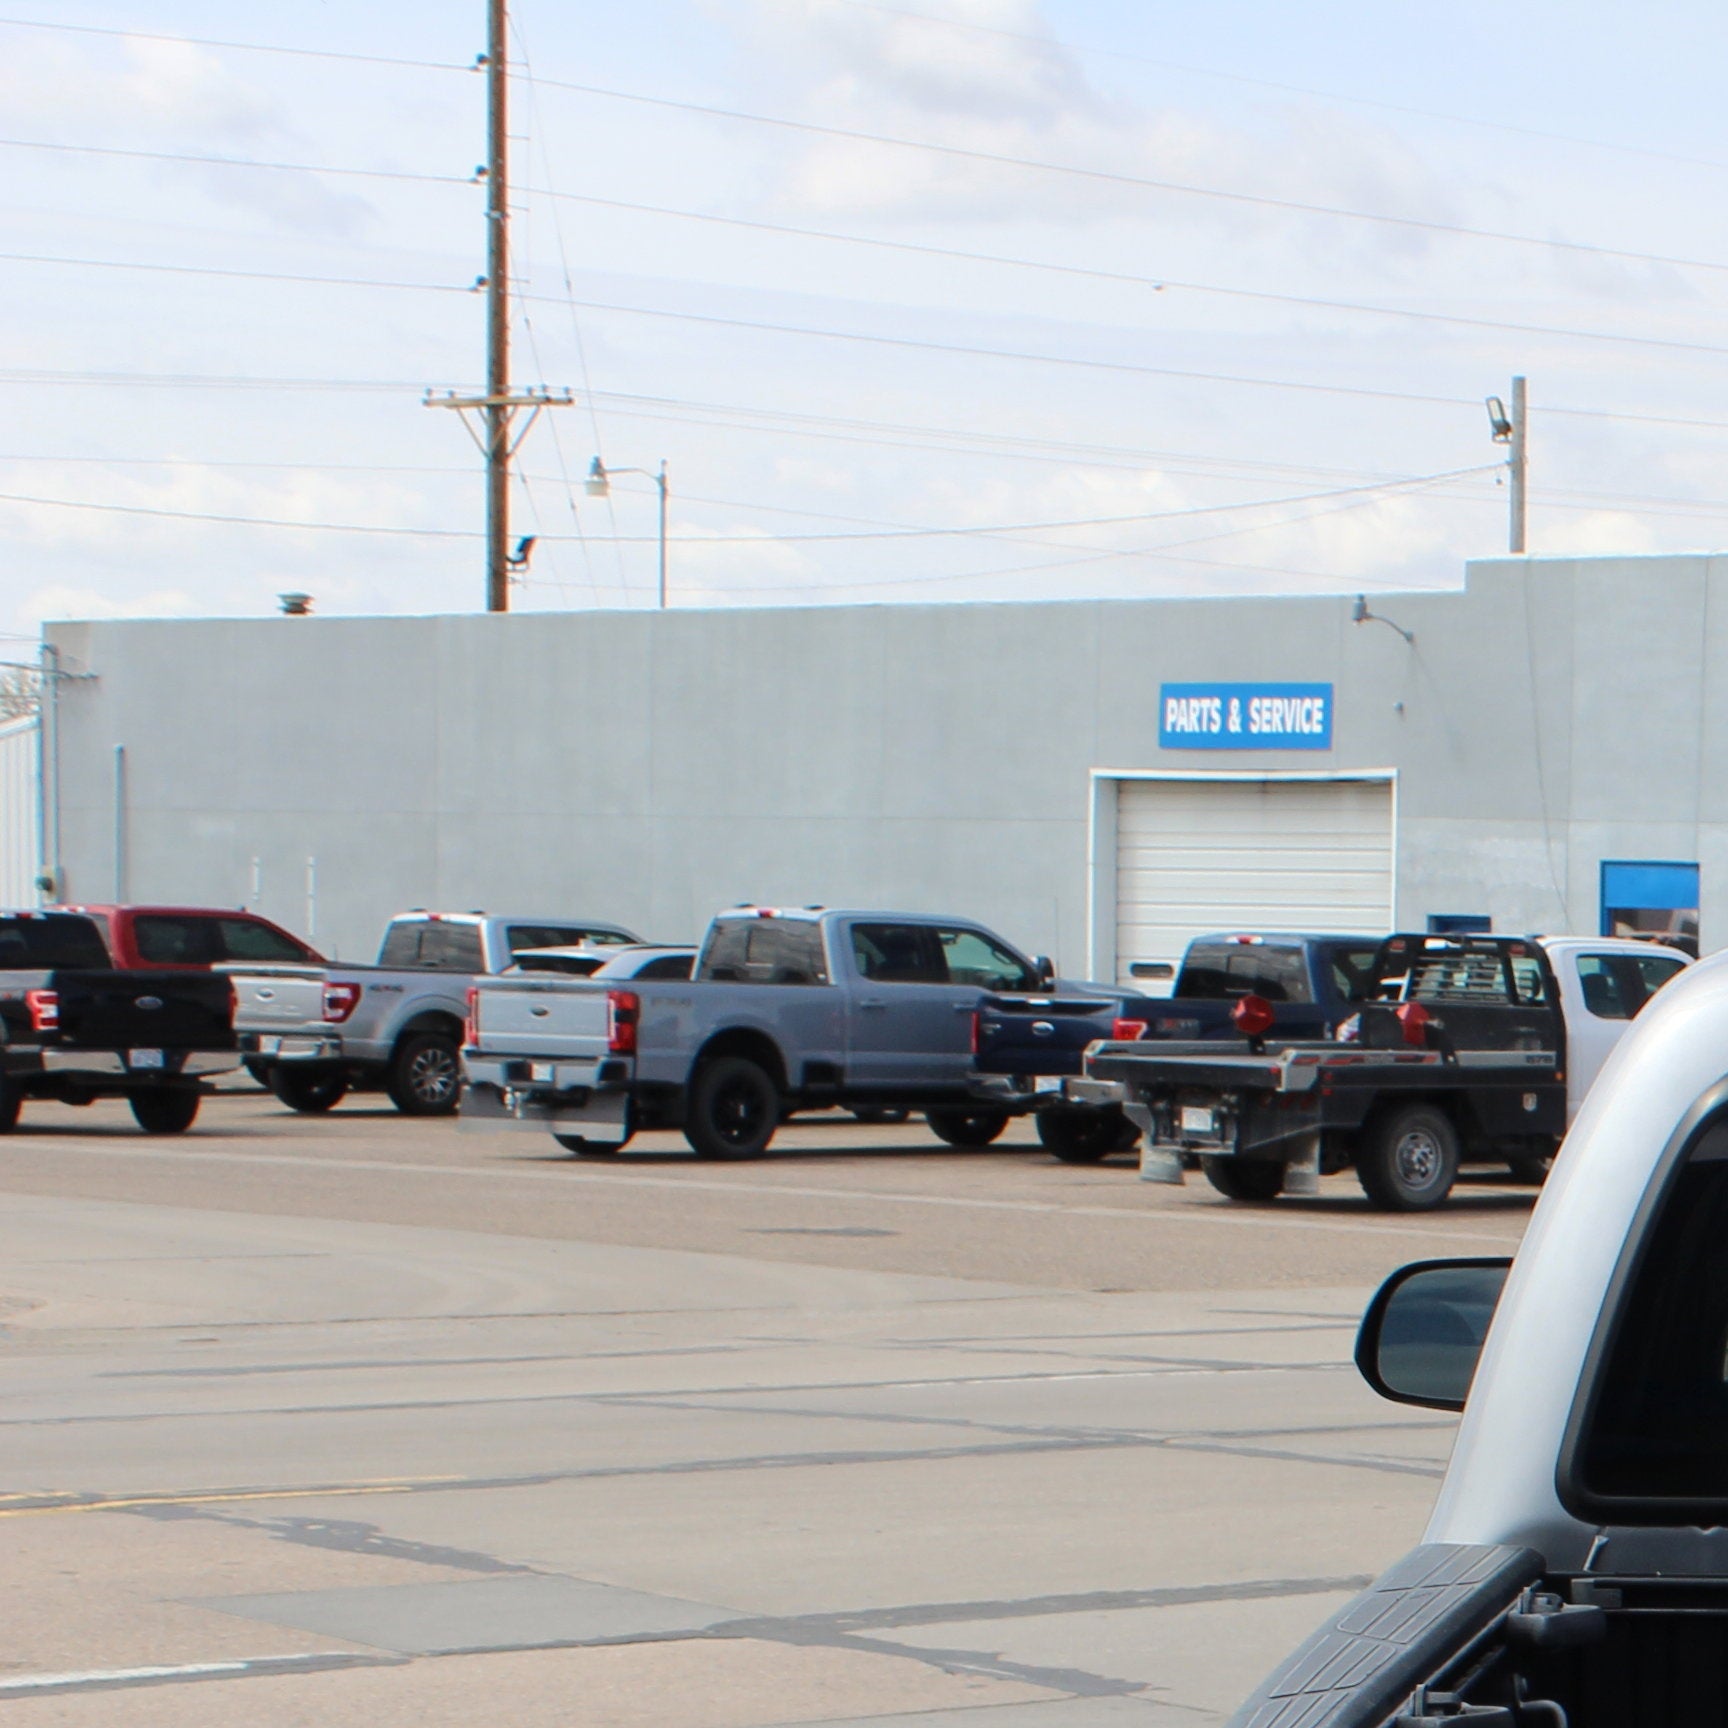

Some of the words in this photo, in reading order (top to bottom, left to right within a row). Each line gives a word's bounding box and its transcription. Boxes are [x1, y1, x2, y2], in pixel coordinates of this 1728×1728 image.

[1165, 698, 1222, 734] PARTS
[1228, 698, 1243, 733] &
[1249, 698, 1325, 734] SERVICE
